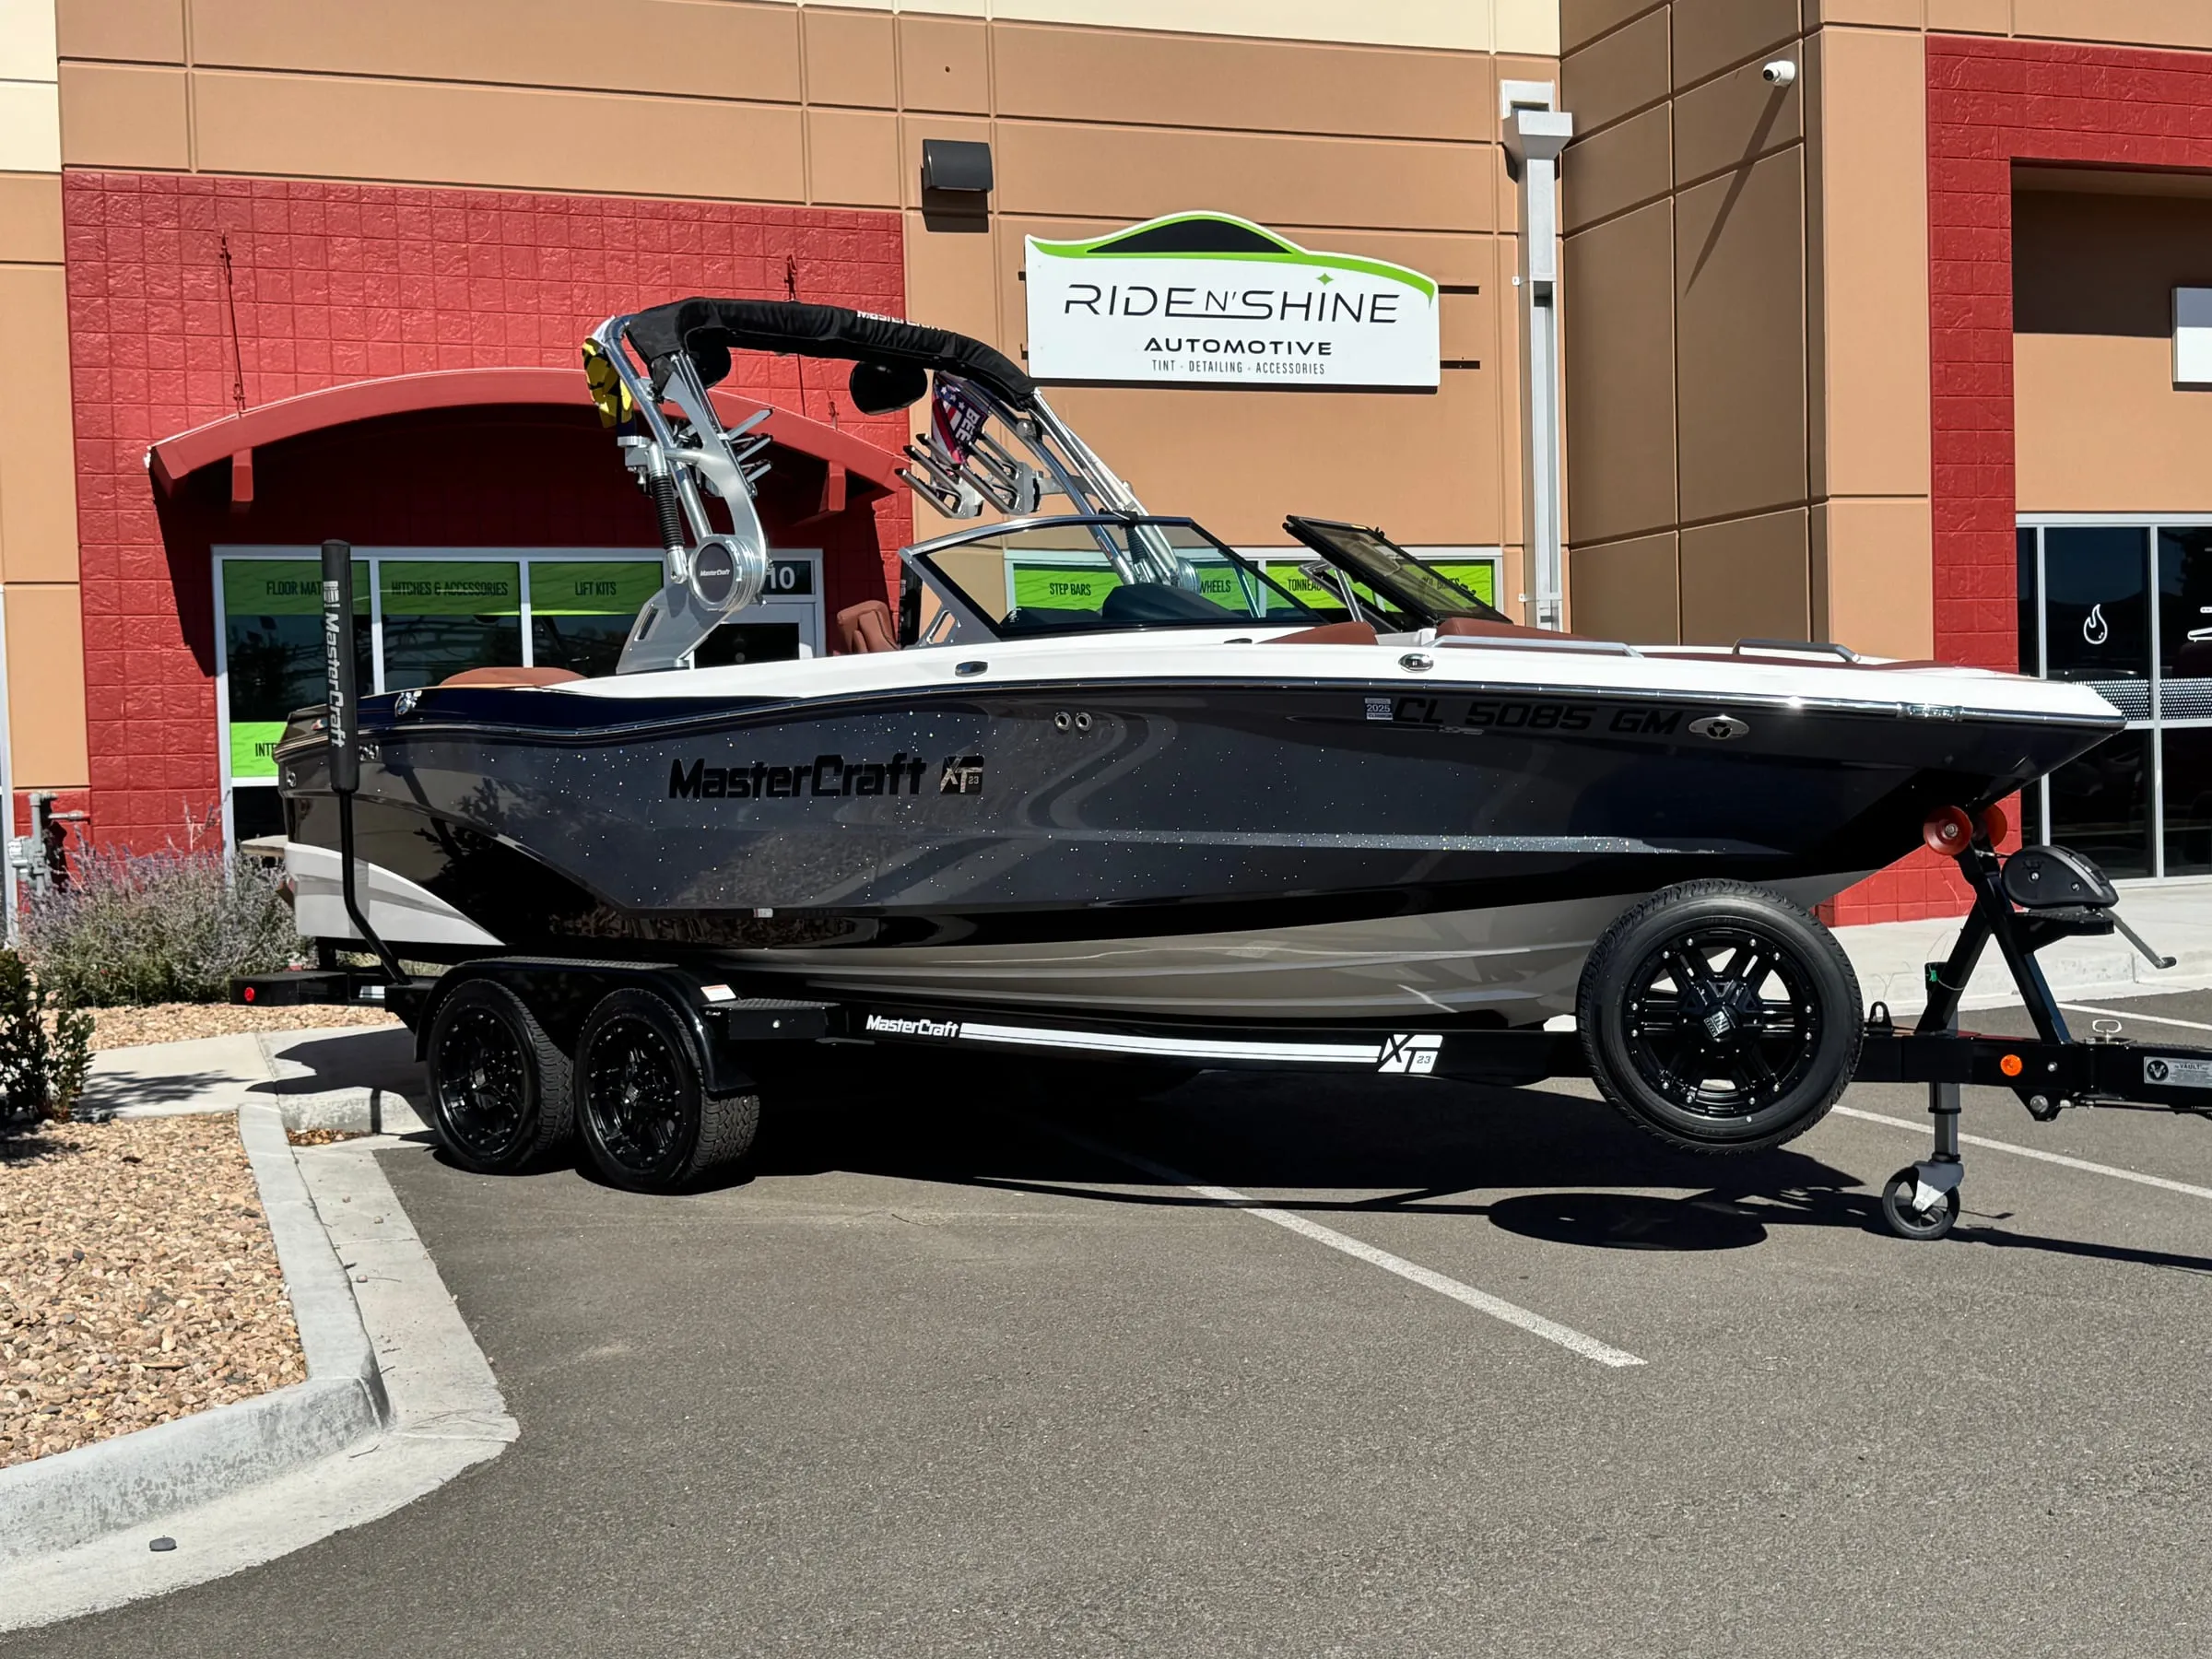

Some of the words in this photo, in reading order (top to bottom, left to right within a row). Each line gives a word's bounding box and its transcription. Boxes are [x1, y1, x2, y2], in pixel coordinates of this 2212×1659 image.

[1144, 337, 1332, 356] AUTOMOTIVE
[1152, 359, 1176, 371] TINT
[1188, 360, 1242, 373] DETAILING
[1255, 362, 1325, 375] ACCESSORIES
[700, 569, 731, 577] MasterCraft
[266, 581, 298, 595] FLOOR
[300, 581, 322, 595] MAT
[391, 582, 432, 596] HITCHES
[434, 582, 441, 595] &
[443, 582, 509, 596] ACCESSORIES
[575, 581, 593, 595] LIFT
[596, 582, 617, 595] KITS
[1049, 582, 1069, 595] STEP
[1070, 583, 1091, 596] BARS
[325, 612, 347, 747] MasterCraft
[1366, 703, 1391, 712] 2025
[1394, 697, 1445, 724] CL
[1465, 702, 1599, 731] 5085
[1609, 709, 1684, 735] GM
[668, 753, 927, 799] MasterCraft
[866, 1014, 959, 1038] MasterCraft
[1417, 1055, 1431, 1065] 23
